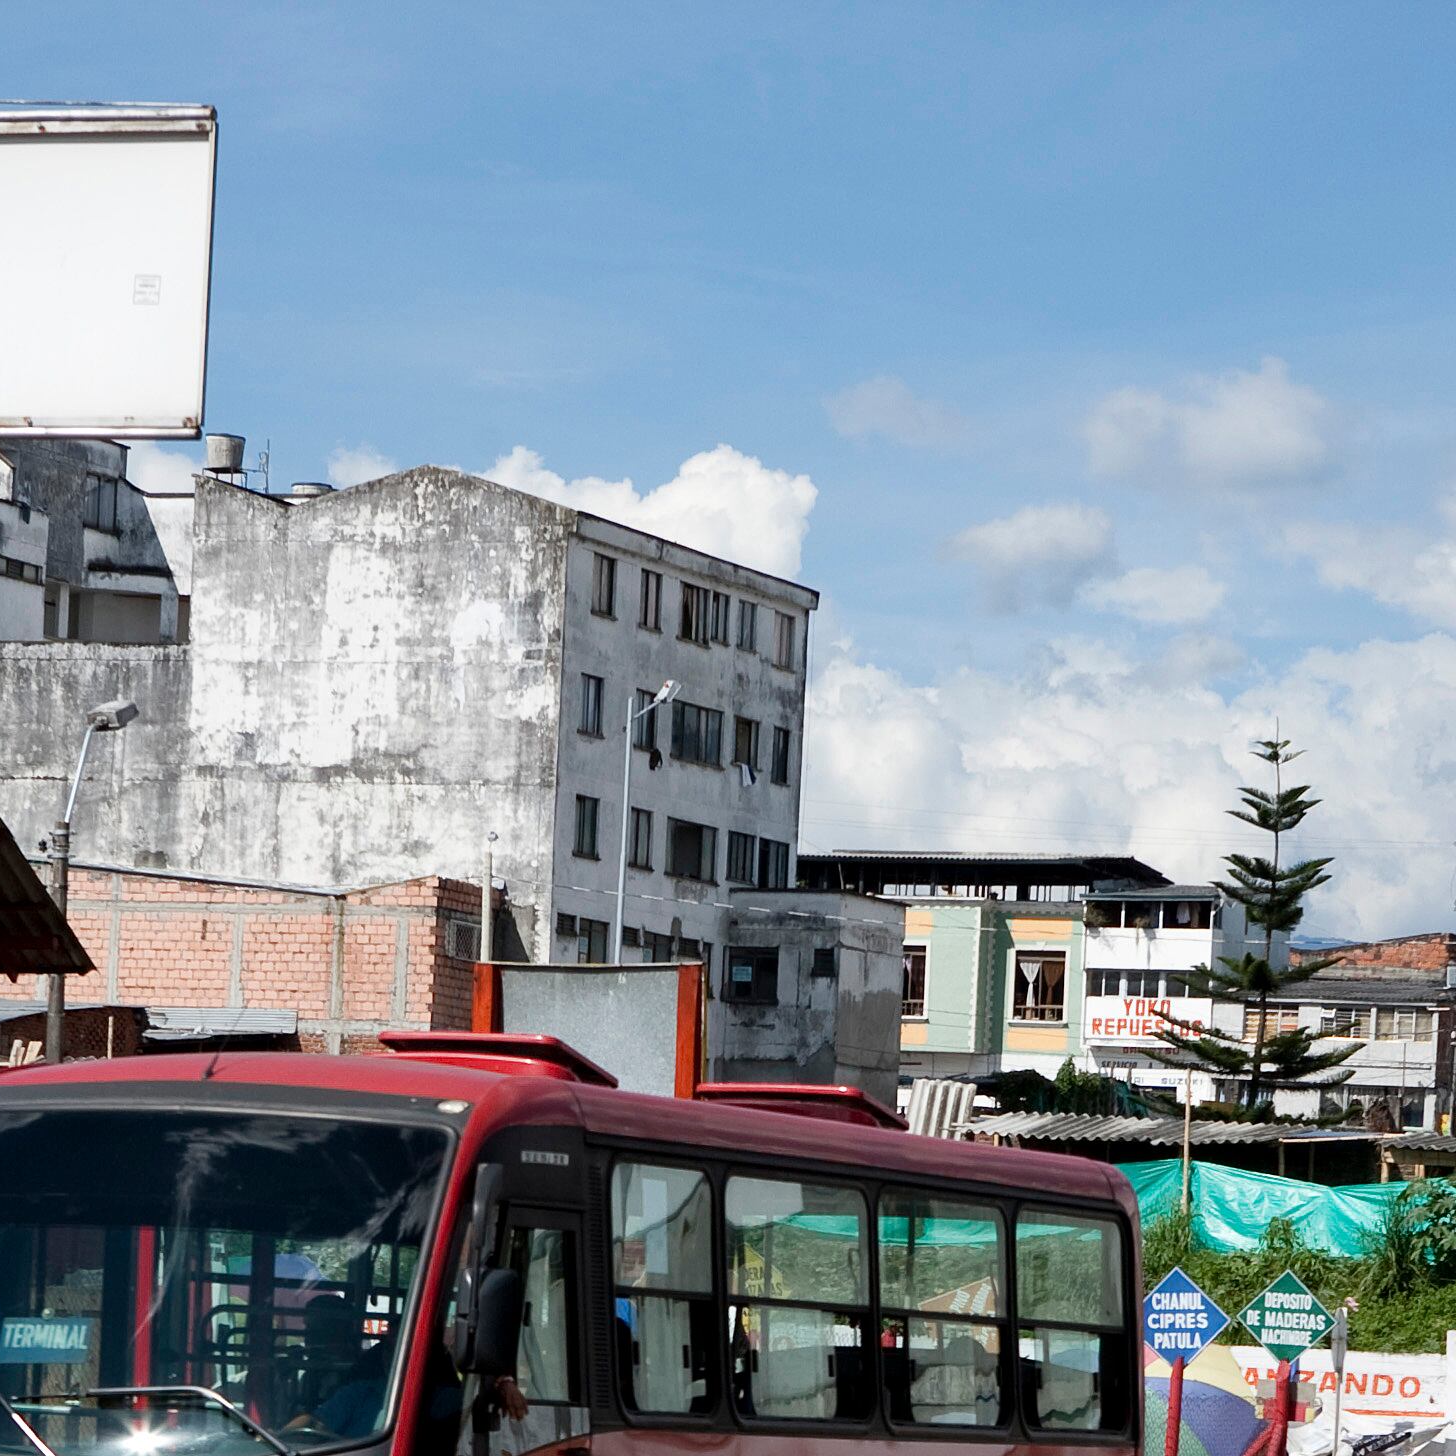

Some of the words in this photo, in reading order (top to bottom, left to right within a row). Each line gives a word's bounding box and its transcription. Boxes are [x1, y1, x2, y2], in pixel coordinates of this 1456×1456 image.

[1123, 999, 1171, 1017] YOKO
[1151, 1292, 1205, 1310] CHANUL
[1264, 1292, 1312, 1311] DEPOSITO
[1147, 1313, 1209, 1329] CIPRES
[1246, 1310, 1261, 1326] DE
[1264, 1310, 1326, 1330] MADERAS
[3, 1323, 88, 1350] TERMINAL
[1153, 1332, 1202, 1350] PATULA
